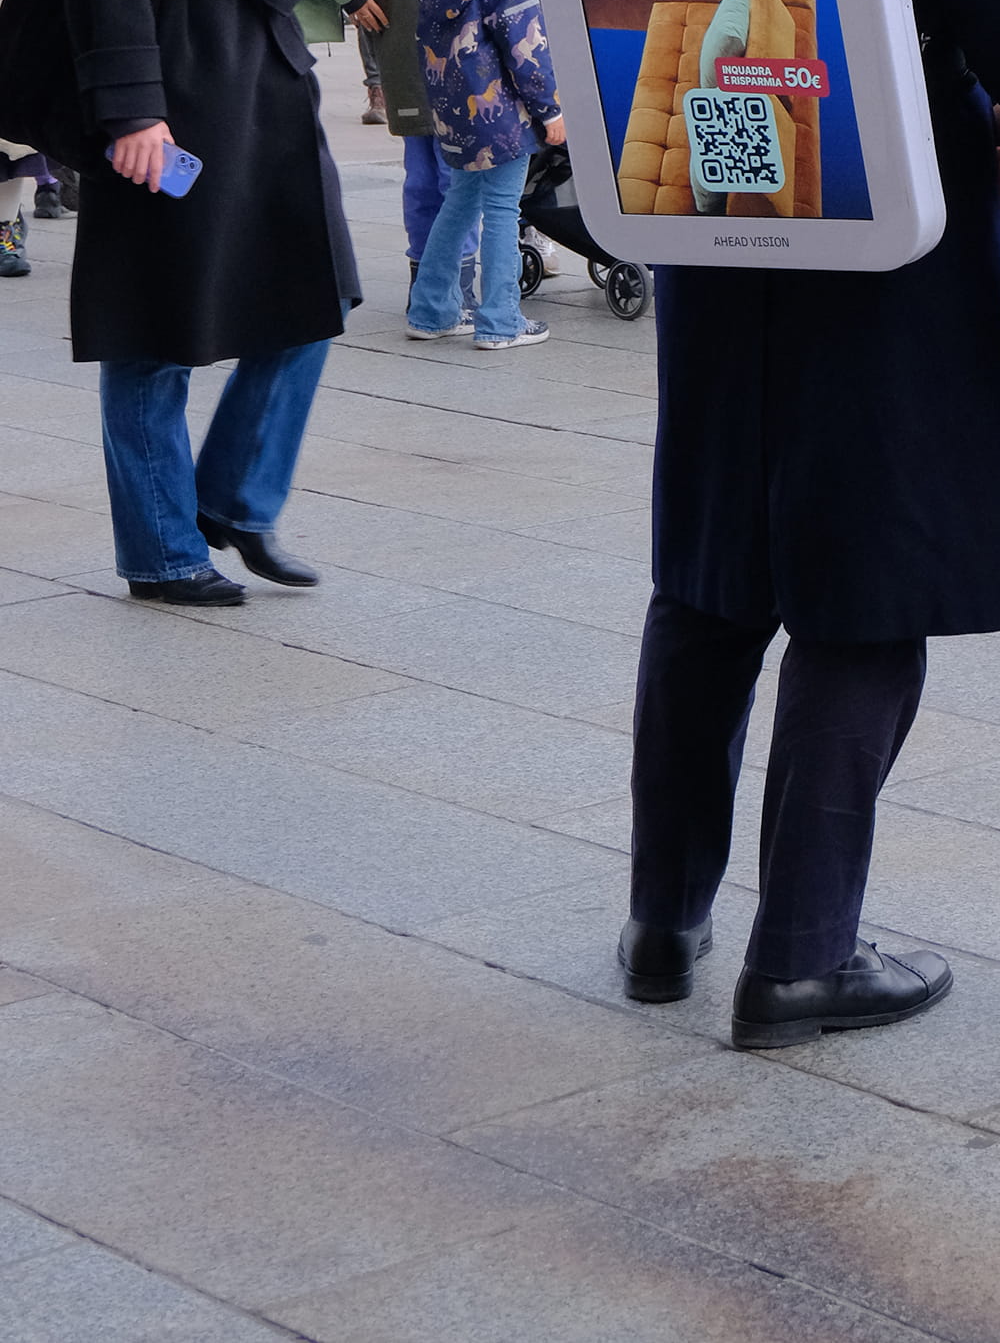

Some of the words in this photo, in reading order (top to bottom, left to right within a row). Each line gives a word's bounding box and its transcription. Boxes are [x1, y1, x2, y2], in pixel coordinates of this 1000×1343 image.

[722, 65, 772, 76] INQUADRA
[723, 75, 731, 85] E
[731, 76, 783, 87] RISPARMIA
[784, 67, 822, 89] 50€
[714, 236, 748, 247] AHEAD
[749, 236, 790, 247] VISION
